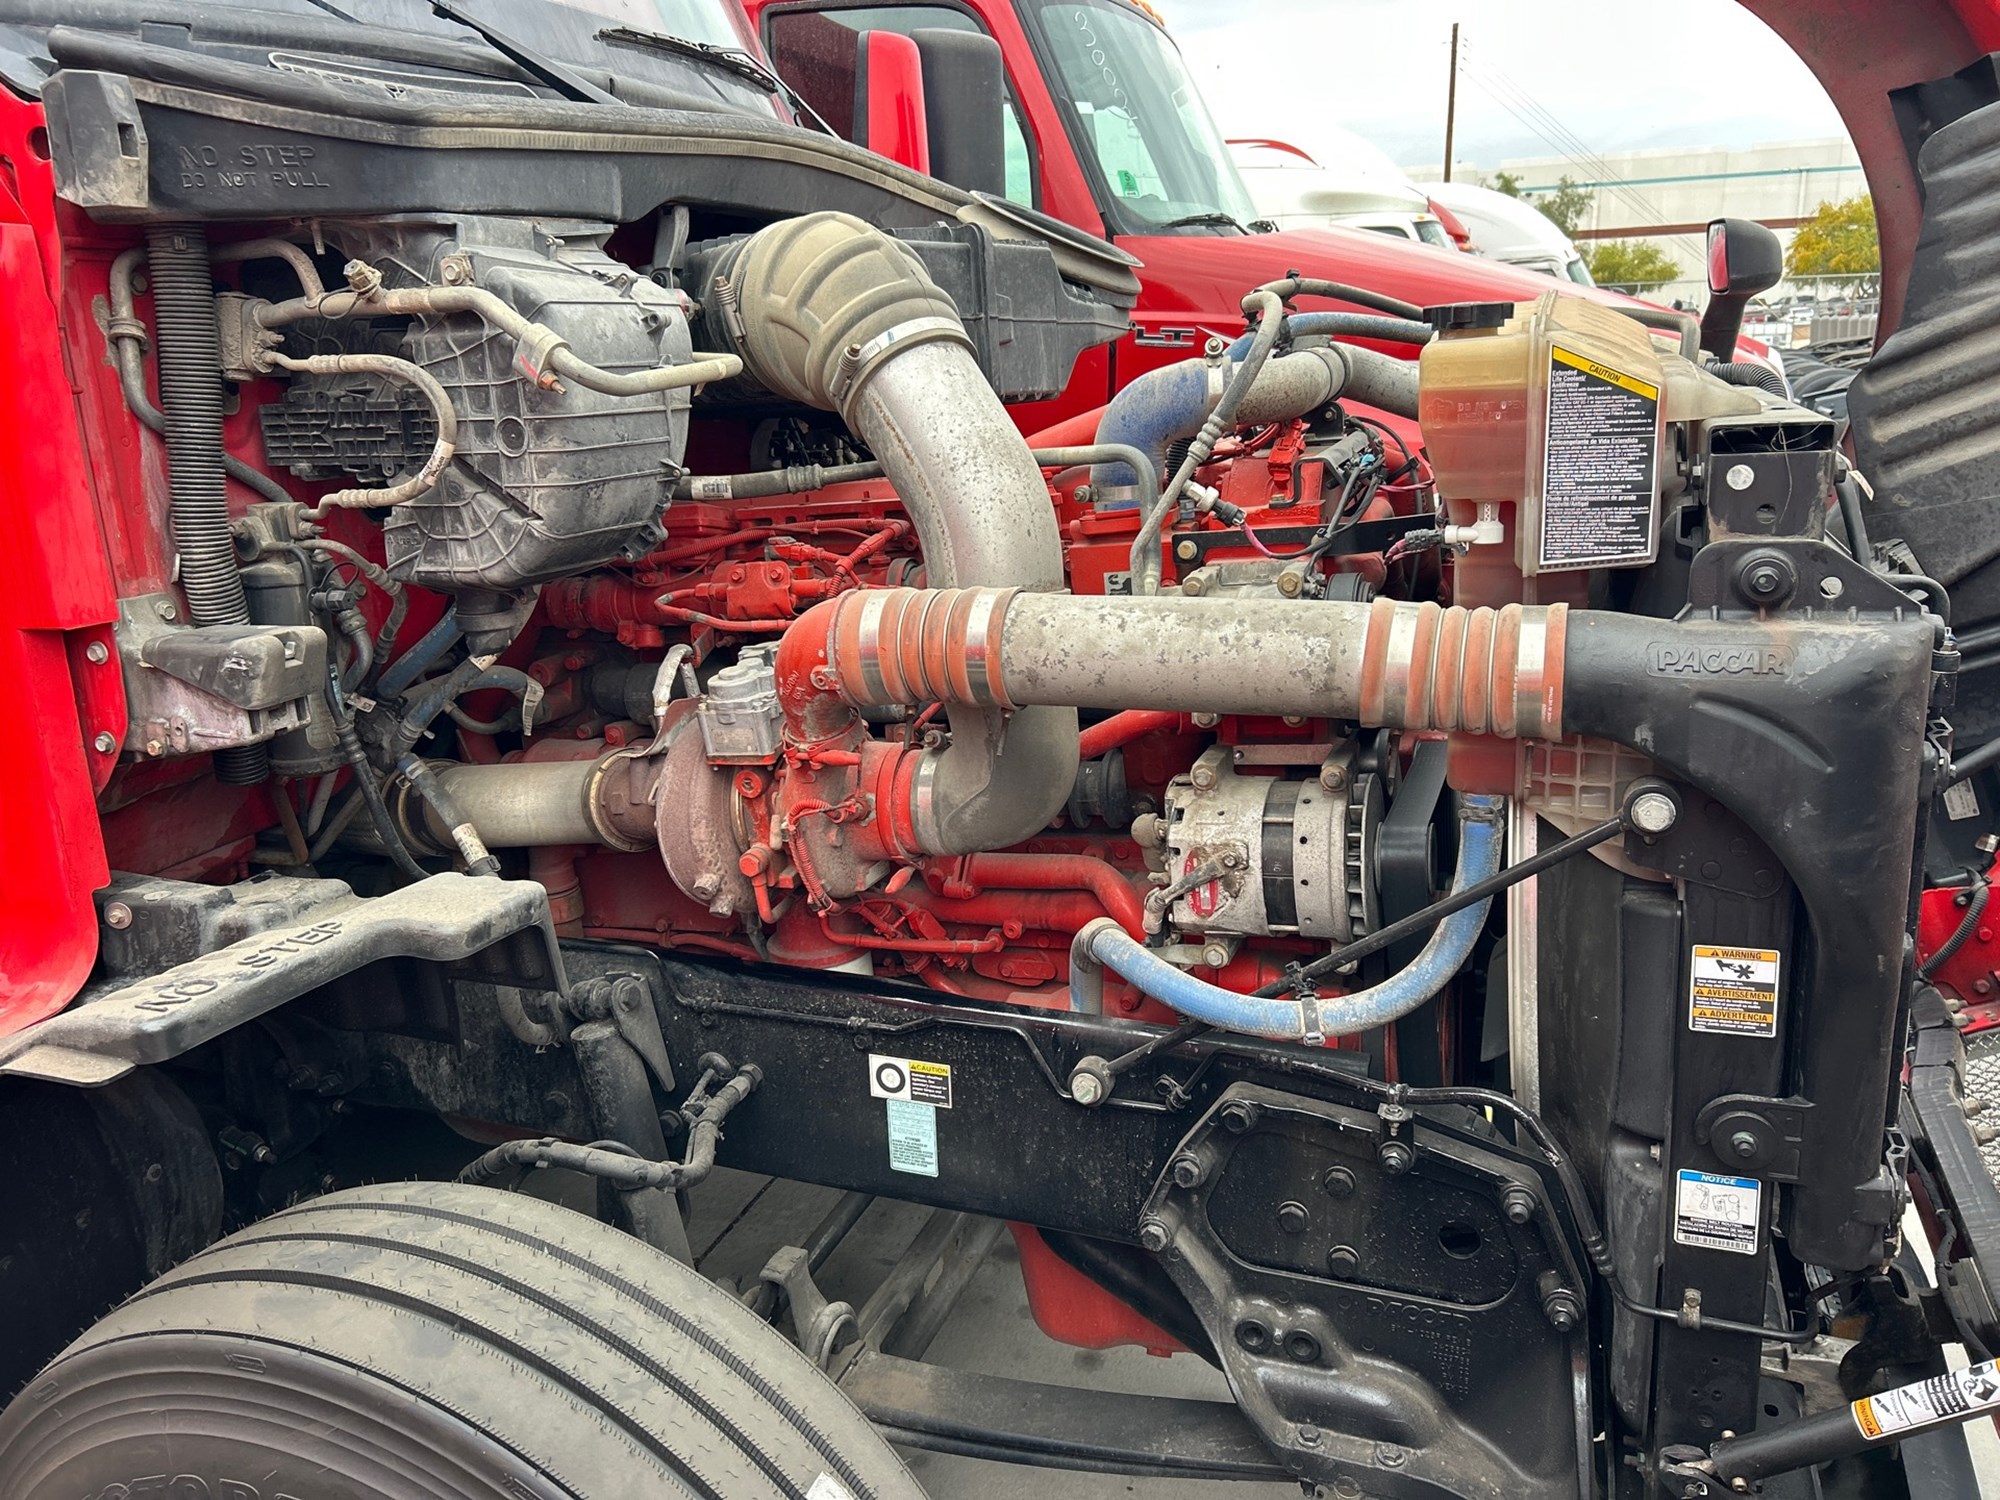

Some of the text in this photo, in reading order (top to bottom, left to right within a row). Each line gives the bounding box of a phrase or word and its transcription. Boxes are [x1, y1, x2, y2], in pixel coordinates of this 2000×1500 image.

[179, 144, 316, 168] NO STEP
[180, 171, 331, 188] DO NOT PULL
[1135, 327, 1195, 343] LT
[1588, 364, 1621, 383] CAUTION
[1656, 648, 1785, 676] PACCAR
[1721, 950, 1762, 960] WARNING
[134, 919, 343, 1013] NO STEP
[1707, 989, 1773, 1001] AVERTISSEMENT
[1710, 1010, 1767, 1021] ADVERTENCIA
[916, 1064, 947, 1074] CAUTION
[1701, 1175, 1737, 1185] NOTICE
[1859, 1400, 1872, 1427] ARNING
